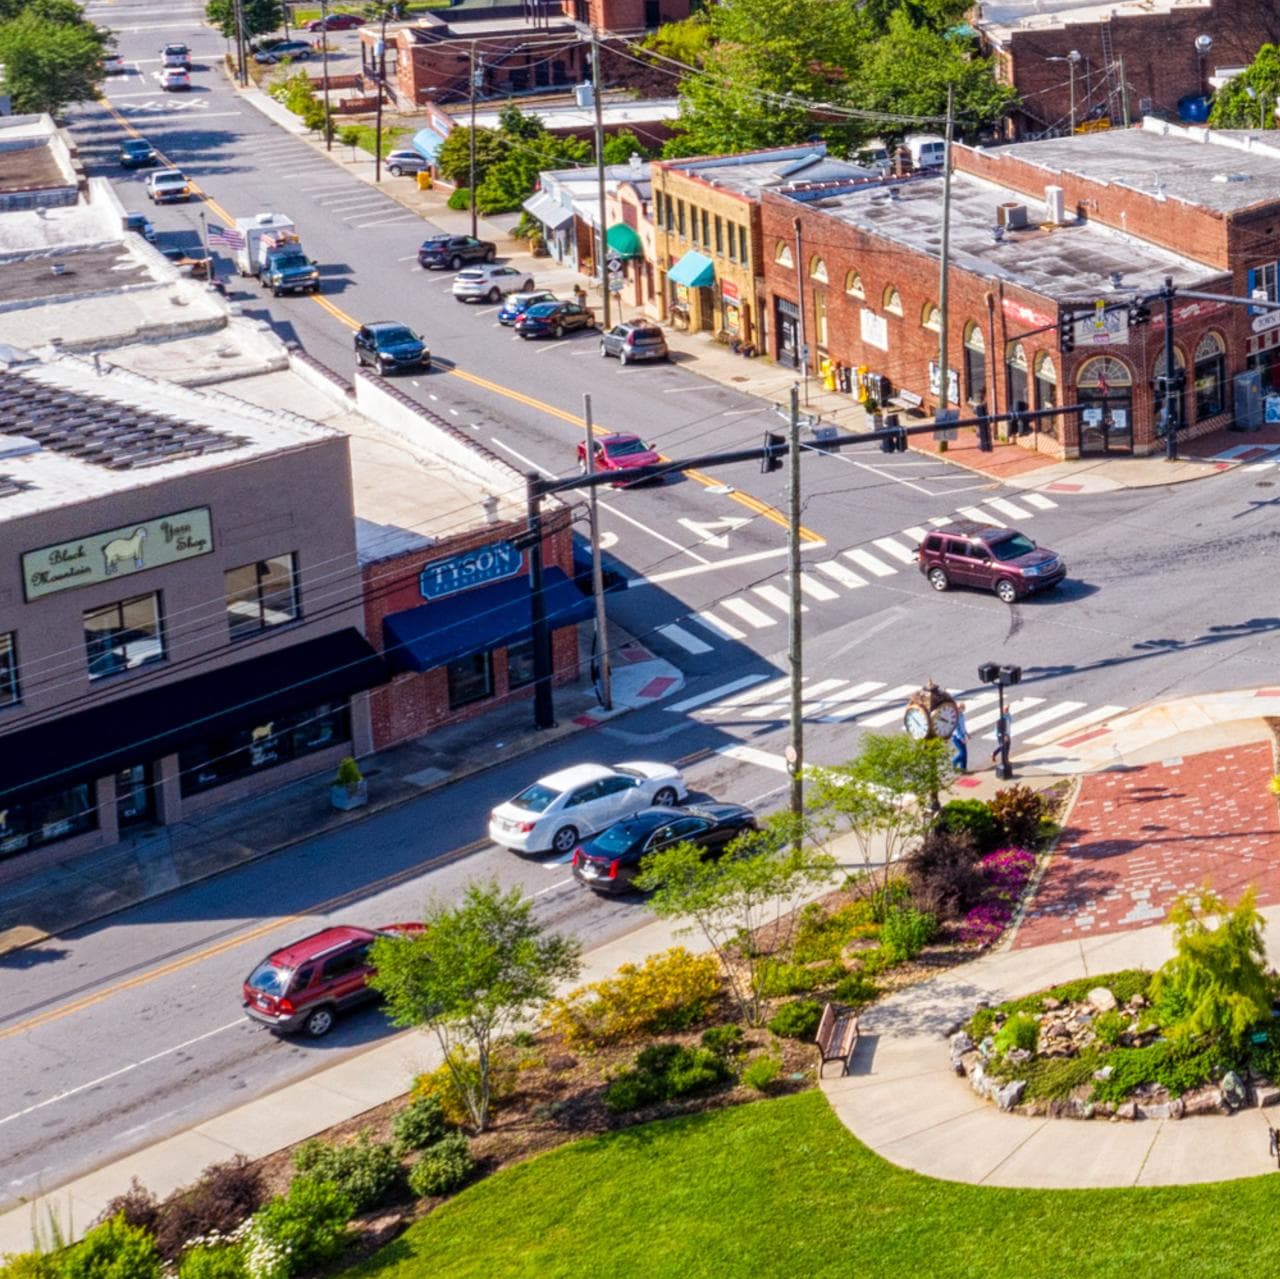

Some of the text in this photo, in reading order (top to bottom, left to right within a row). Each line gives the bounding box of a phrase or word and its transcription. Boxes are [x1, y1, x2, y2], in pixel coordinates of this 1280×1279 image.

[160, 521, 191, 543] Yarn
[176, 537, 207, 552] Shop
[49, 545, 86, 566] Black
[431, 544, 510, 584] TYSON
[31, 566, 92, 587] Mountain
